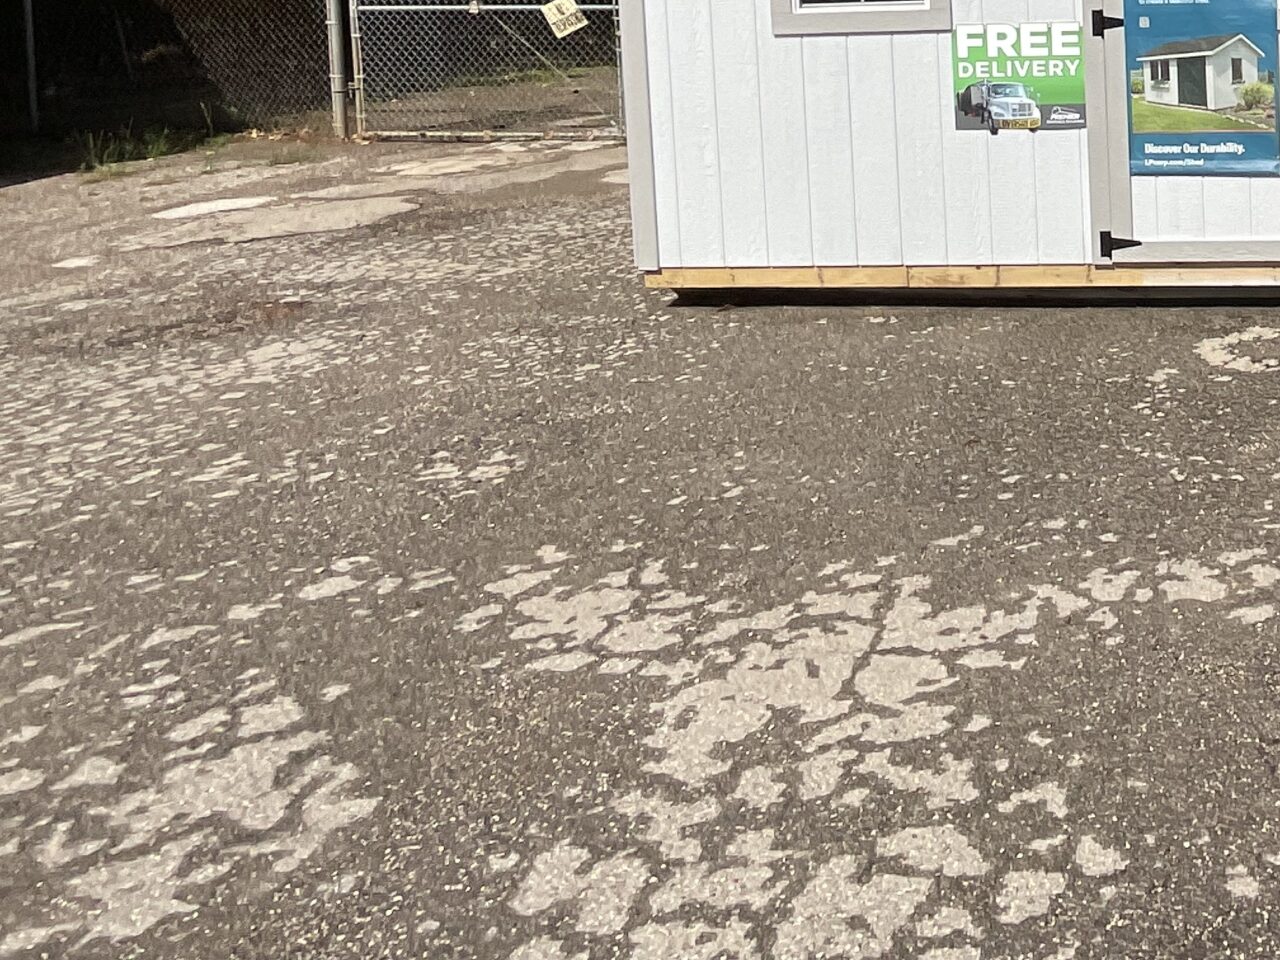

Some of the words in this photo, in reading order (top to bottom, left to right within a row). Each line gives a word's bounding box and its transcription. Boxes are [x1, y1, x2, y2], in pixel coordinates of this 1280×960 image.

[956, 22, 1080, 58] FREE
[958, 60, 1080, 77] DELIVERY
[1144, 143, 1182, 154] Discover
[1183, 143, 1199, 153] Our
